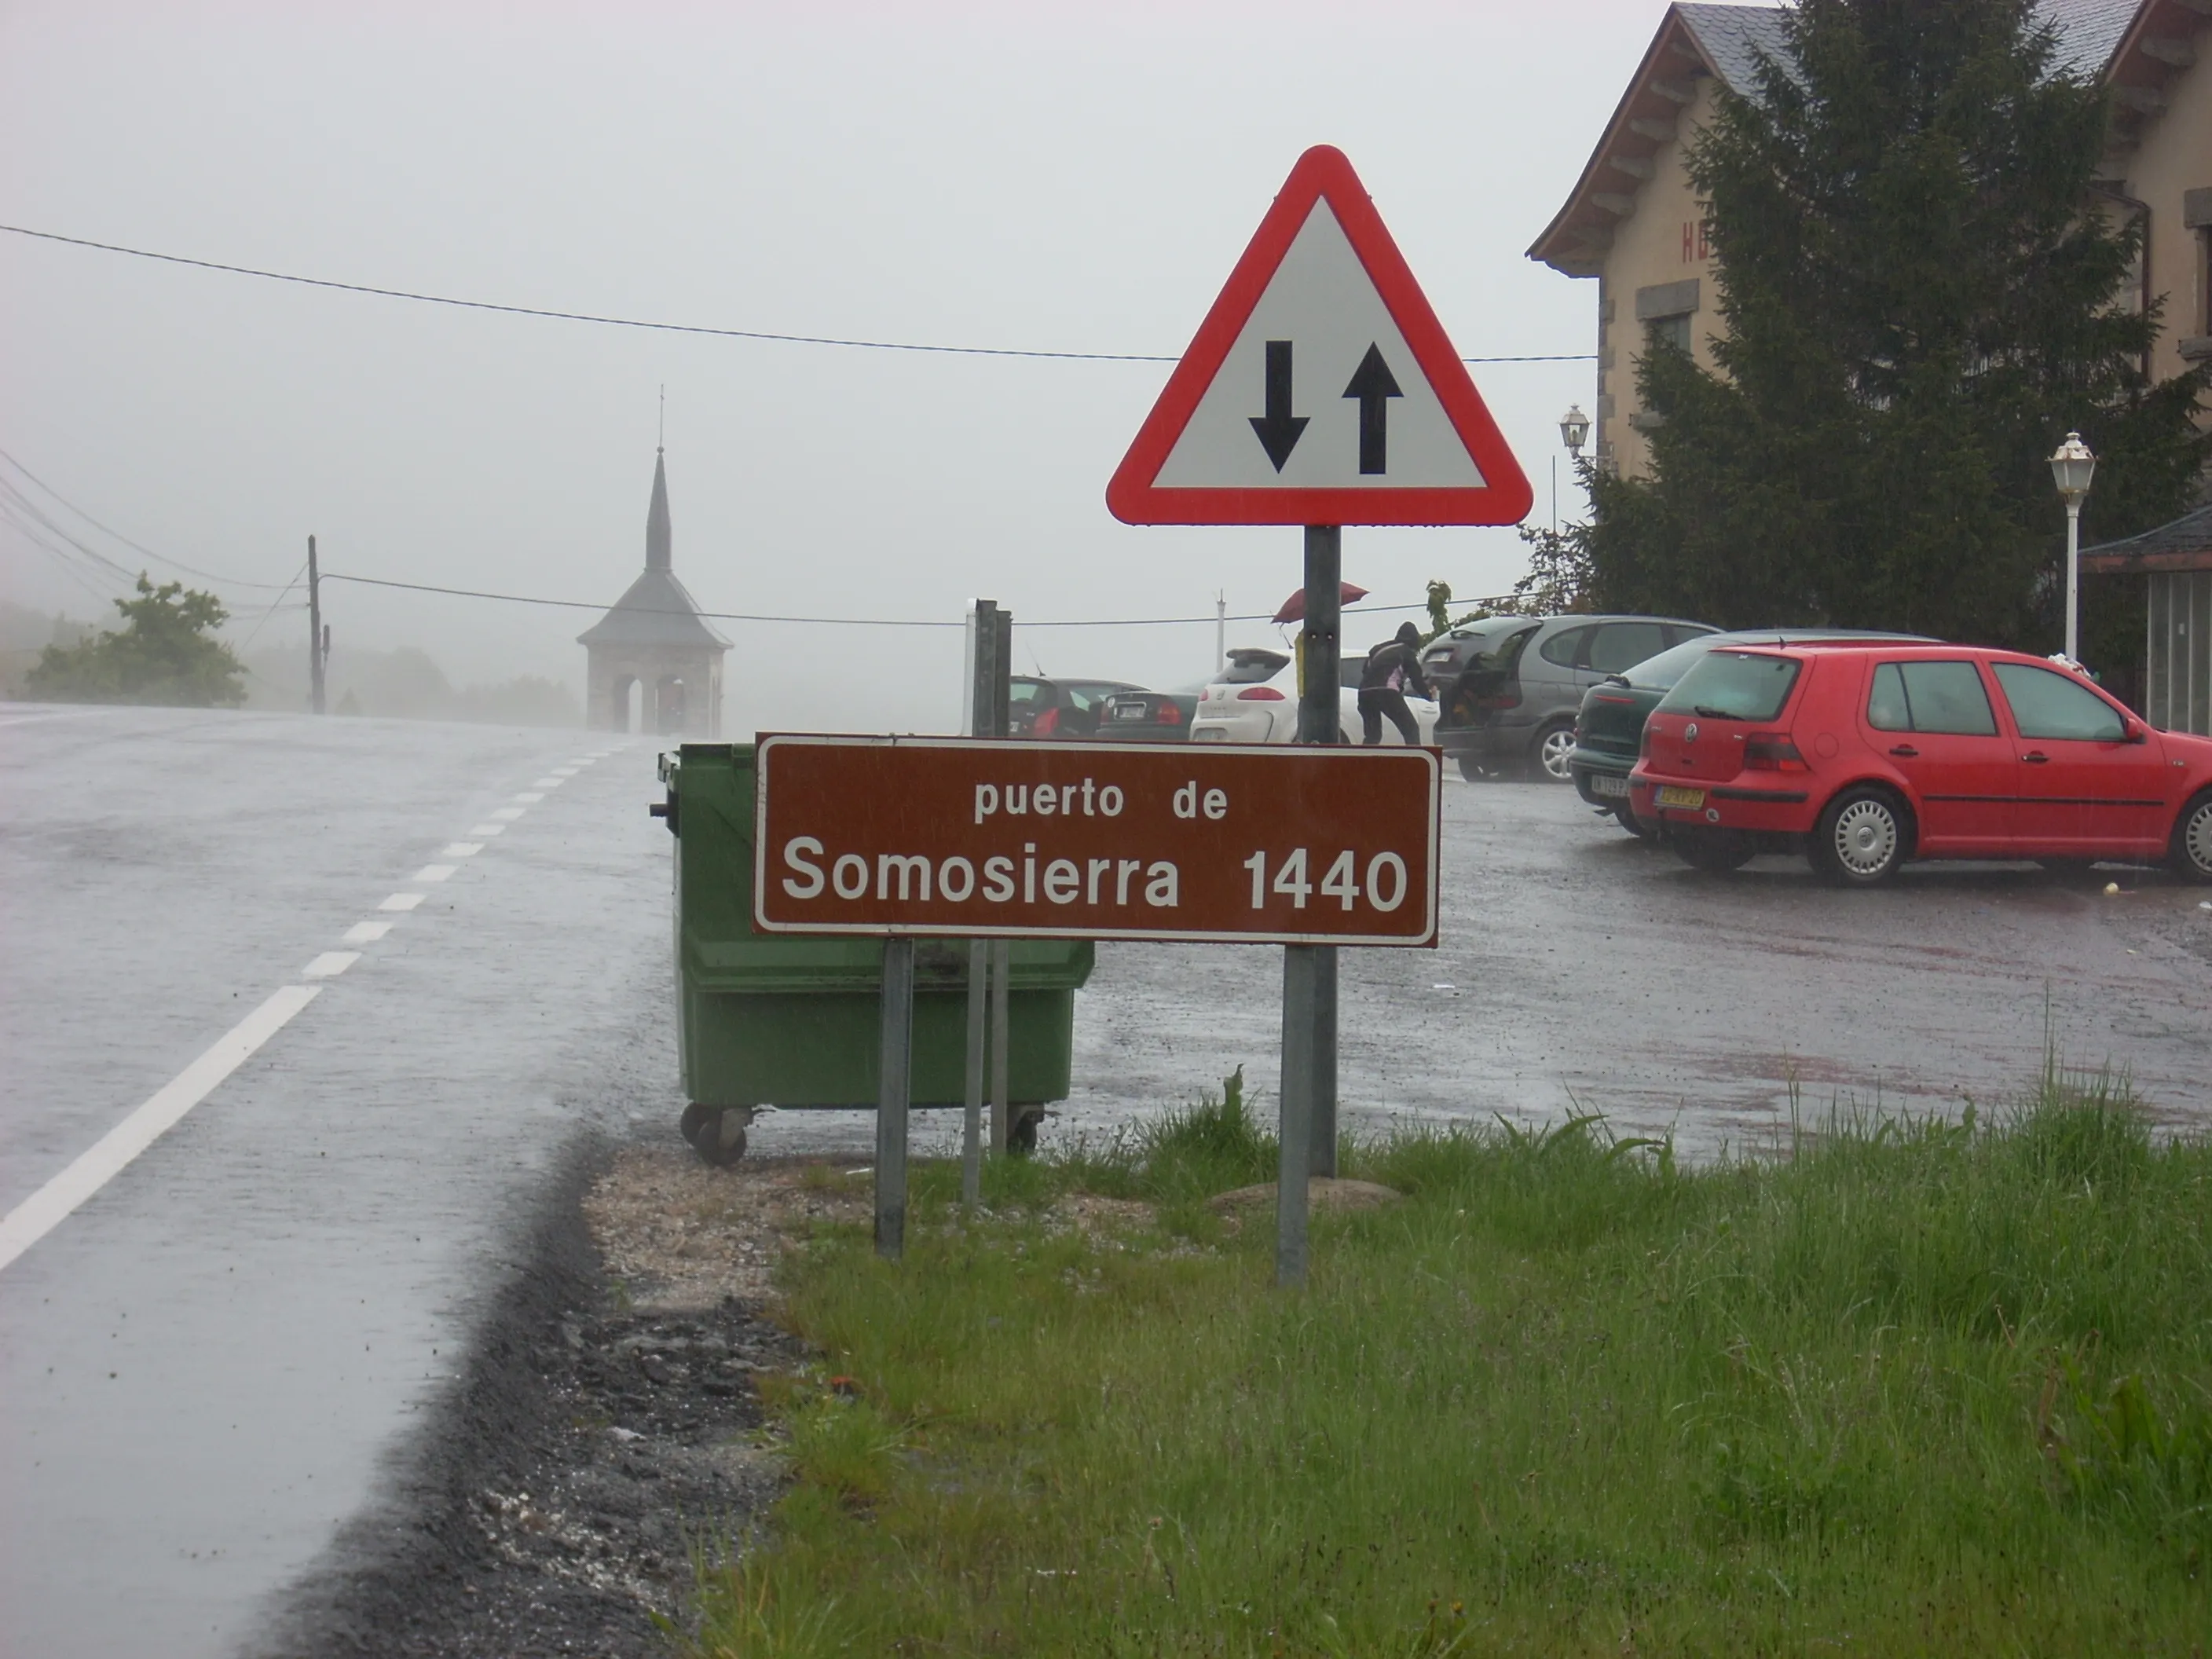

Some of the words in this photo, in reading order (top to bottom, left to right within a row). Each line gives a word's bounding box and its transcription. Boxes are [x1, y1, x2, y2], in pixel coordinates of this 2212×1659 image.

[975, 778, 1123, 824] puerto
[1173, 780, 1227, 819] de
[782, 837, 1178, 907] Somosierra
[1244, 850, 1407, 912] 1440
